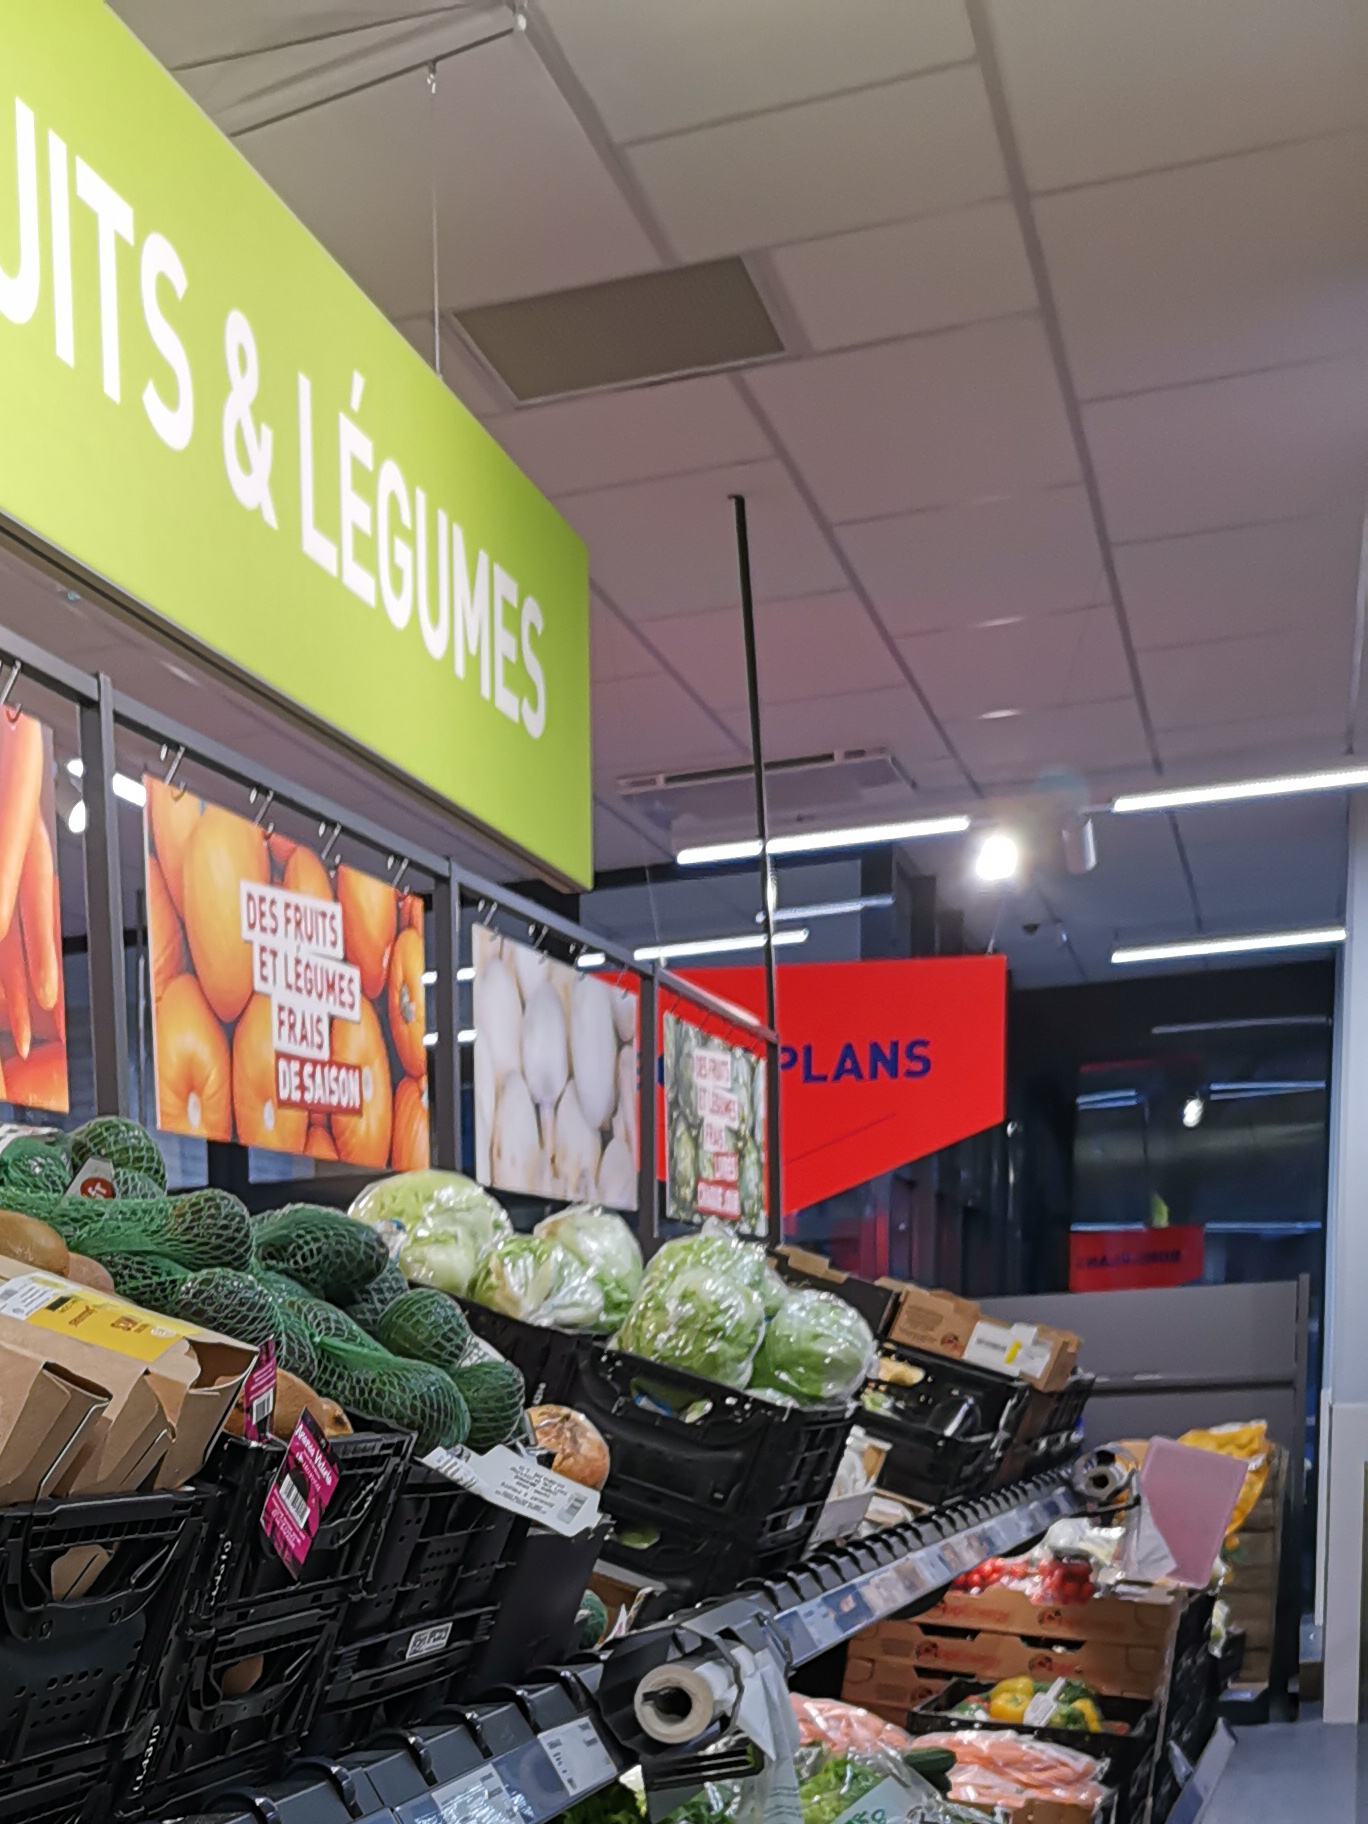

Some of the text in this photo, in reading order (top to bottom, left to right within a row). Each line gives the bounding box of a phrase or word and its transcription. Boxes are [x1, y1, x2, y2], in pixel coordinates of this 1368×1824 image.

[223, 309, 277, 530] &
[298, 369, 547, 740] LÉGUMES
[246, 892, 339, 950] DES FRUITS
[259, 944, 357, 1012] ET LÉGUMES
[277, 1003, 325, 1051] FRAIS
[277, 1057, 361, 1110] DE SAISON
[780, 1039, 931, 1084] PLANS
